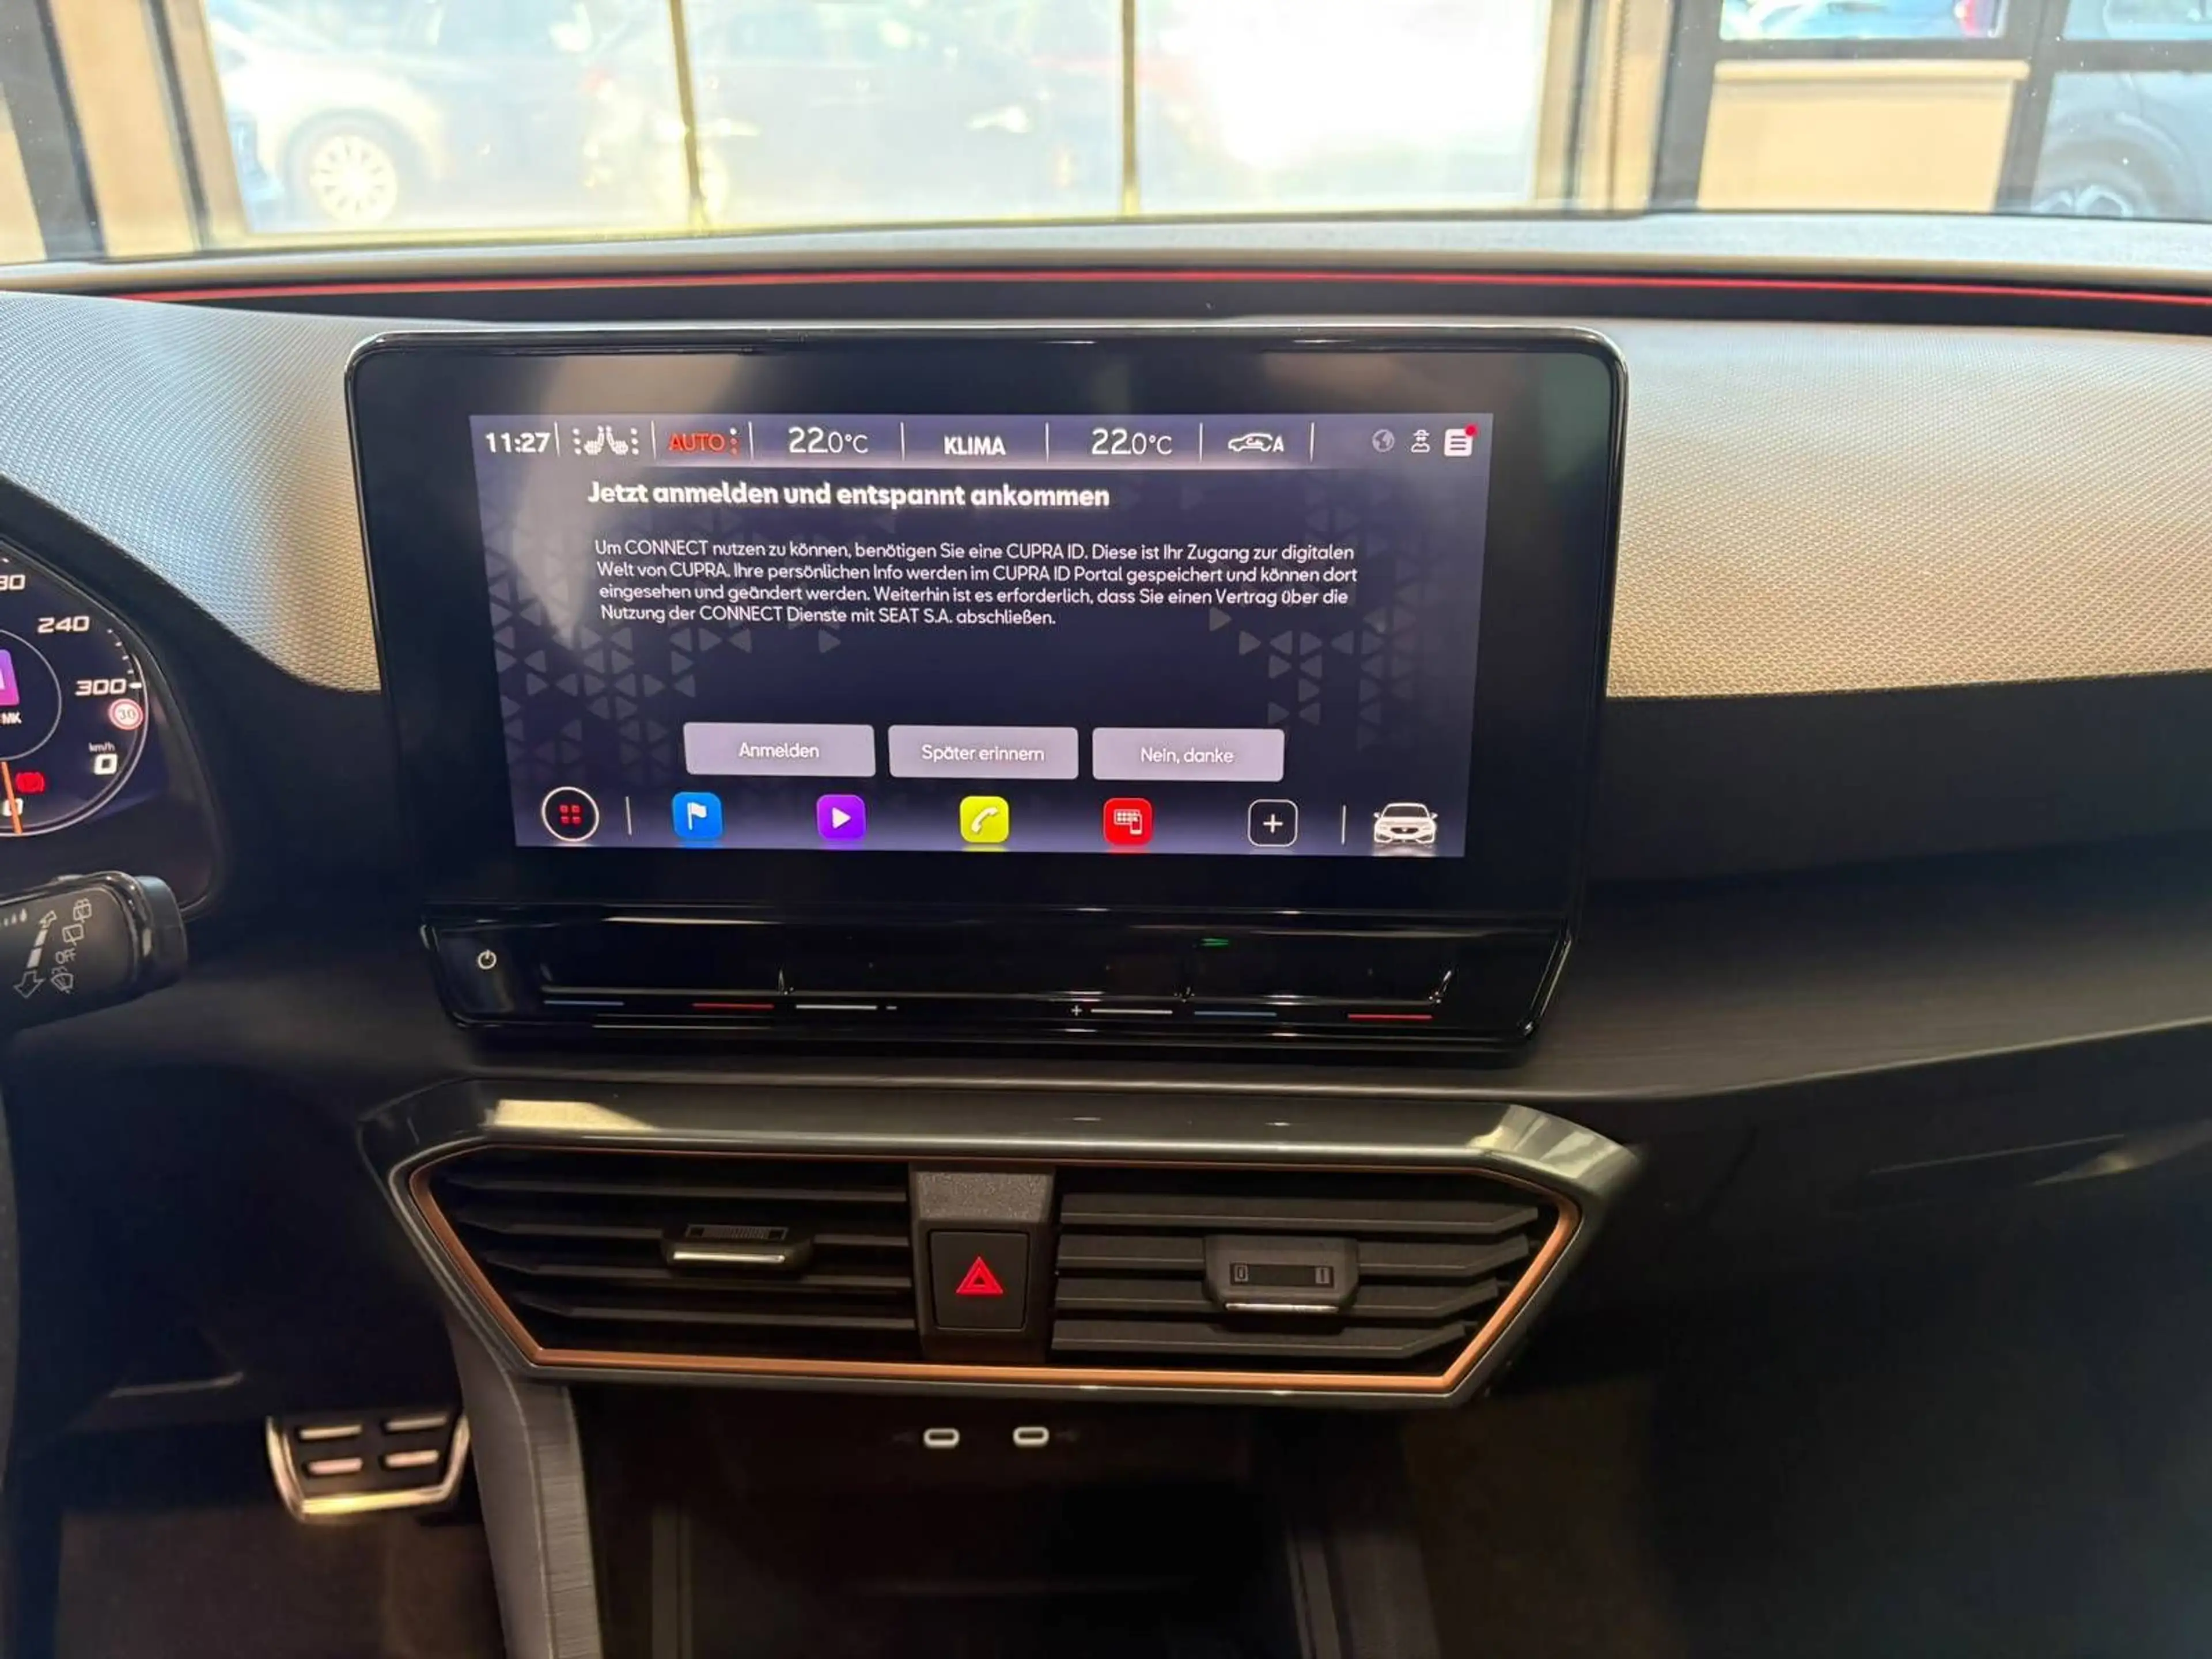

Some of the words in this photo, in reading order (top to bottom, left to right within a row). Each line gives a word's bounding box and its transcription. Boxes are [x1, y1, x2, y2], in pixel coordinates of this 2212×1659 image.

[486, 432, 551, 453] 11:27
[668, 433, 726, 452] AUTO
[944, 436, 1006, 456] KLIMA
[588, 482, 649, 503] Jetzt
[652, 480, 779, 504] anmelden
[783, 482, 832, 505] und
[836, 484, 966, 510] entspannt
[970, 483, 1110, 507] ankommen
[595, 539, 622, 555] Um
[624, 539, 709, 555] CONNECT
[713, 543, 766, 556] nutzen
[768, 544, 786, 556] zu
[789, 540, 852, 559] können,
[854, 541, 937, 562] benötigen
[940, 542, 965, 558] Sie
[968, 543, 1003, 559] eine
[1006, 543, 1065, 559] CUPRA
[1067, 543, 1088, 559] ID.
[1092, 543, 1138, 560] Diese
[1141, 544, 1160, 560] ist
[1164, 544, 1184, 560] Ihr
[1187, 543, 1249, 564] Zugang
[1253, 548, 1278, 560] zur
[1281, 543, 1354, 564] digitalen
[597, 561, 634, 577] Welt
[637, 565, 667, 577] von
[669, 561, 731, 578] CUPRA.
[733, 562, 764, 578] Ihre
[767, 563, 870, 581] persönlichen
[873, 563, 903, 580] Info
[906, 565, 968, 581] werden
[970, 565, 990, 581] im
[993, 565, 1051, 581] CUPRA
[1054, 565, 1071, 582] ID
[1074, 565, 1123, 582] Portal
[1126, 566, 1223, 586] gespeichert
[1226, 566, 1257, 582] und
[1260, 566, 1320, 582] können
[1323, 566, 1358, 582] dort
[599, 583, 692, 602] eingesehen
[694, 584, 724, 599] und
[728, 584, 803, 603] geändert
[805, 585, 870, 601] werden.
[873, 585, 950, 602] Weiterhin
[952, 587, 971, 603] ist
[974, 591, 994, 603] es
[997, 587, 1094, 605] erforderlich,
[1097, 588, 1136, 604] dass
[1139, 588, 1164, 604] Sie
[1168, 588, 1212, 604] einen
[1215, 588, 1278, 608] Vertrag
[1281, 588, 1320, 604] über
[1323, 588, 1349, 604] die
[601, 604, 666, 624] Nutzung
[668, 604, 696, 620] der
[699, 605, 781, 622] CONNECT
[786, 605, 847, 622] Dienste
[851, 607, 876, 623] mit
[878, 607, 919, 623] SEAT
[923, 608, 953, 624] S.A.
[956, 608, 1056, 624] abschließen.
[38, 616, 89, 633] 240
[75, 678, 127, 696] 300
[118, 708, 137, 720] 30
[88, 741, 116, 752] km/h
[738, 742, 820, 758] Anmelden
[922, 744, 976, 763] Später
[979, 746, 1044, 761] erinnern
[1141, 747, 1180, 764] Nein,
[1183, 747, 1234, 763] danke
[94, 753, 118, 775] 0
[55, 948, 77, 964] OFF
